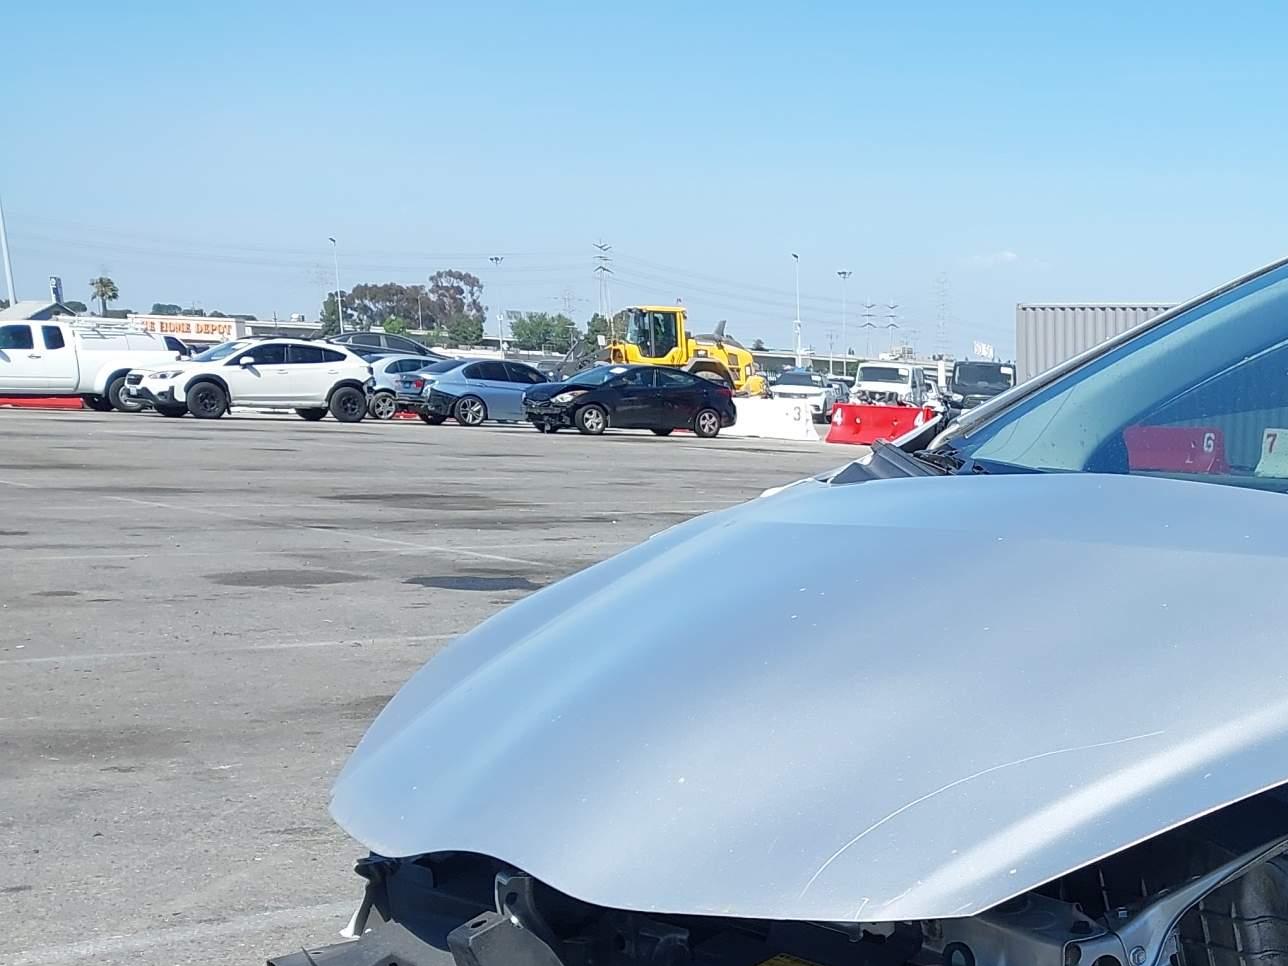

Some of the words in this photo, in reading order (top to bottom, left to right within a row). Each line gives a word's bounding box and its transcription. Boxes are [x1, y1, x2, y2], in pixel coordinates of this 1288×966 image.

[160, 321, 191, 334] HOME
[195, 323, 232, 336] DEPOT
[793, 406, 801, 421] 3
[833, 407, 843, 426] 4
[1203, 432, 1216, 453] 6
[1266, 433, 1277, 453] 7
